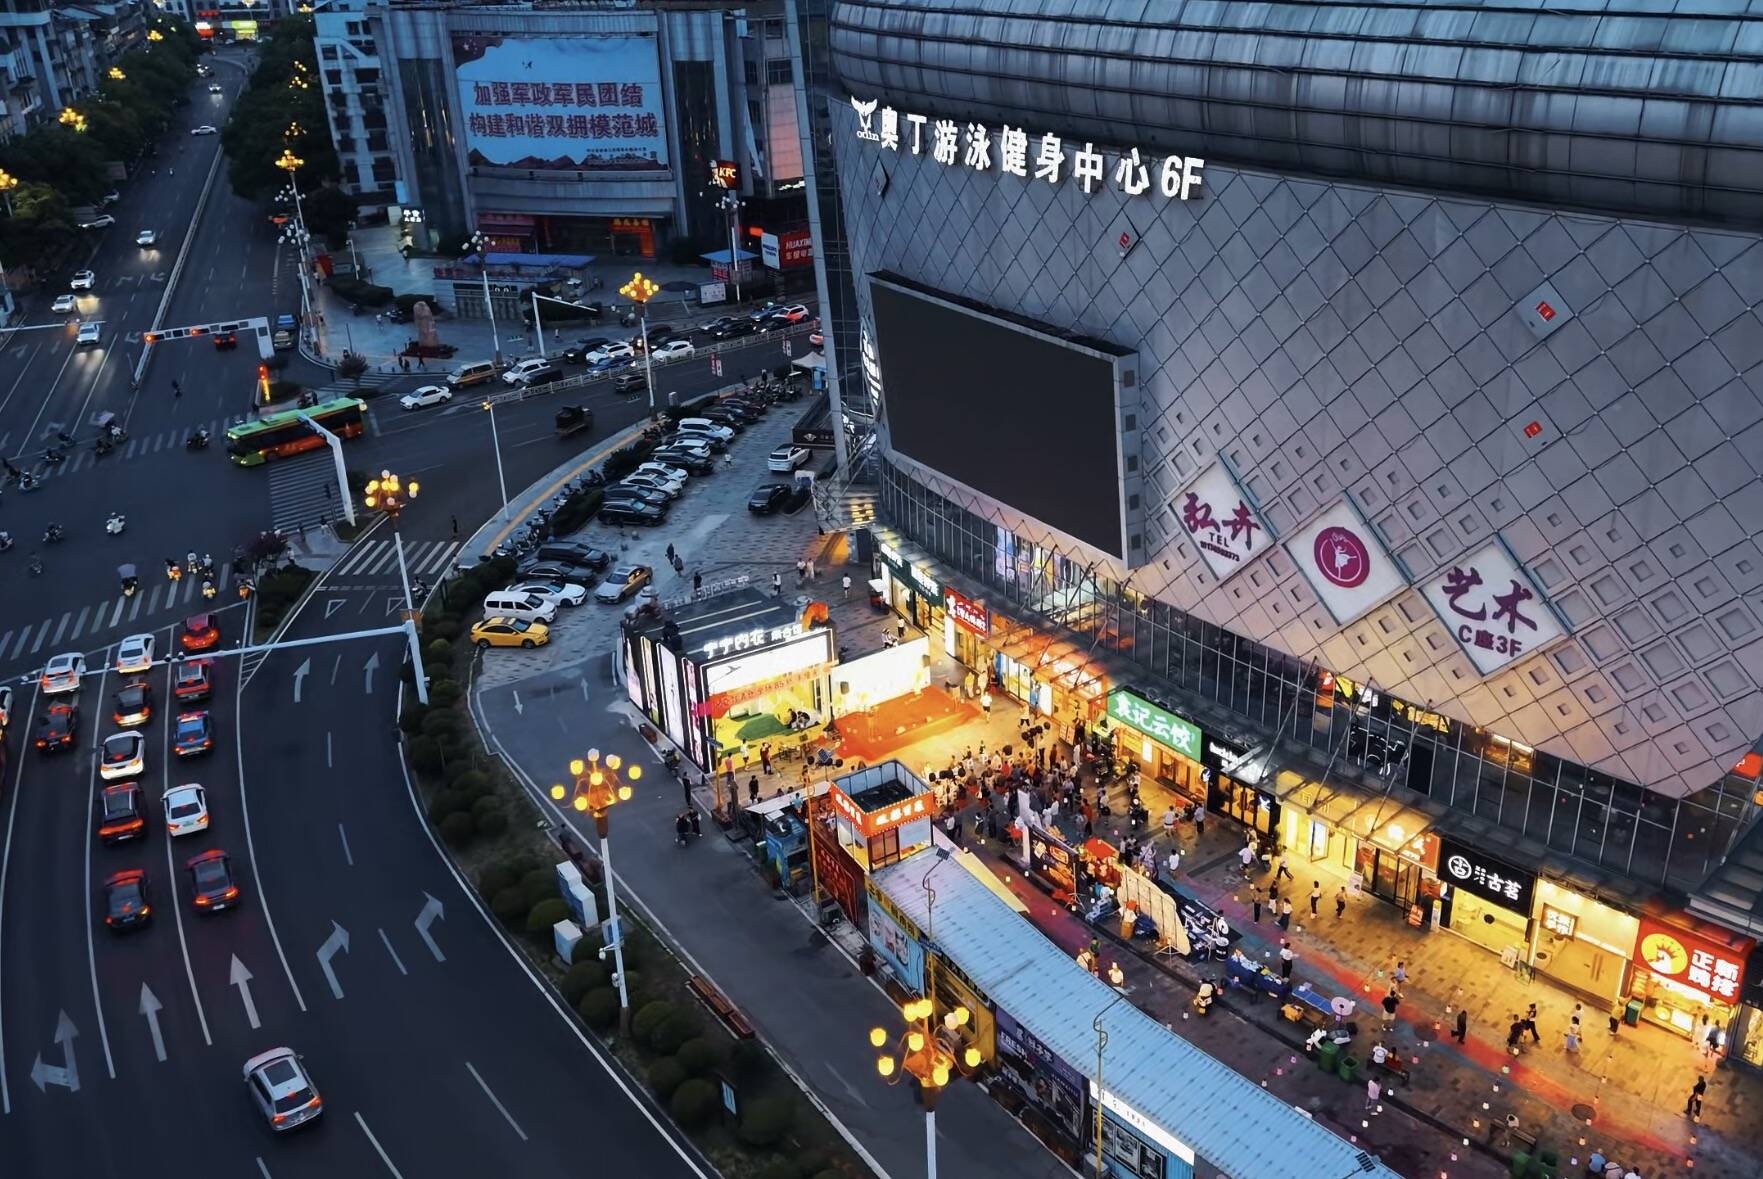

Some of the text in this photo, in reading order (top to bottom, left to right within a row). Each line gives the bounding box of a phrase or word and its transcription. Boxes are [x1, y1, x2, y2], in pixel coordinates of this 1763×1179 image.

[474, 81, 643, 107] 加强军政军民团结
[469, 112, 659, 138] 构建和谐双拥模范城
[857, 129, 880, 142] odin
[880, 105, 1205, 201] 奥丁游泳健身中心 6F
[720, 167, 736, 178] KFC
[1209, 532, 1229, 548] TEL
[1442, 566, 1538, 634] 艺术
[1486, 872, 1523, 901] 古茗
